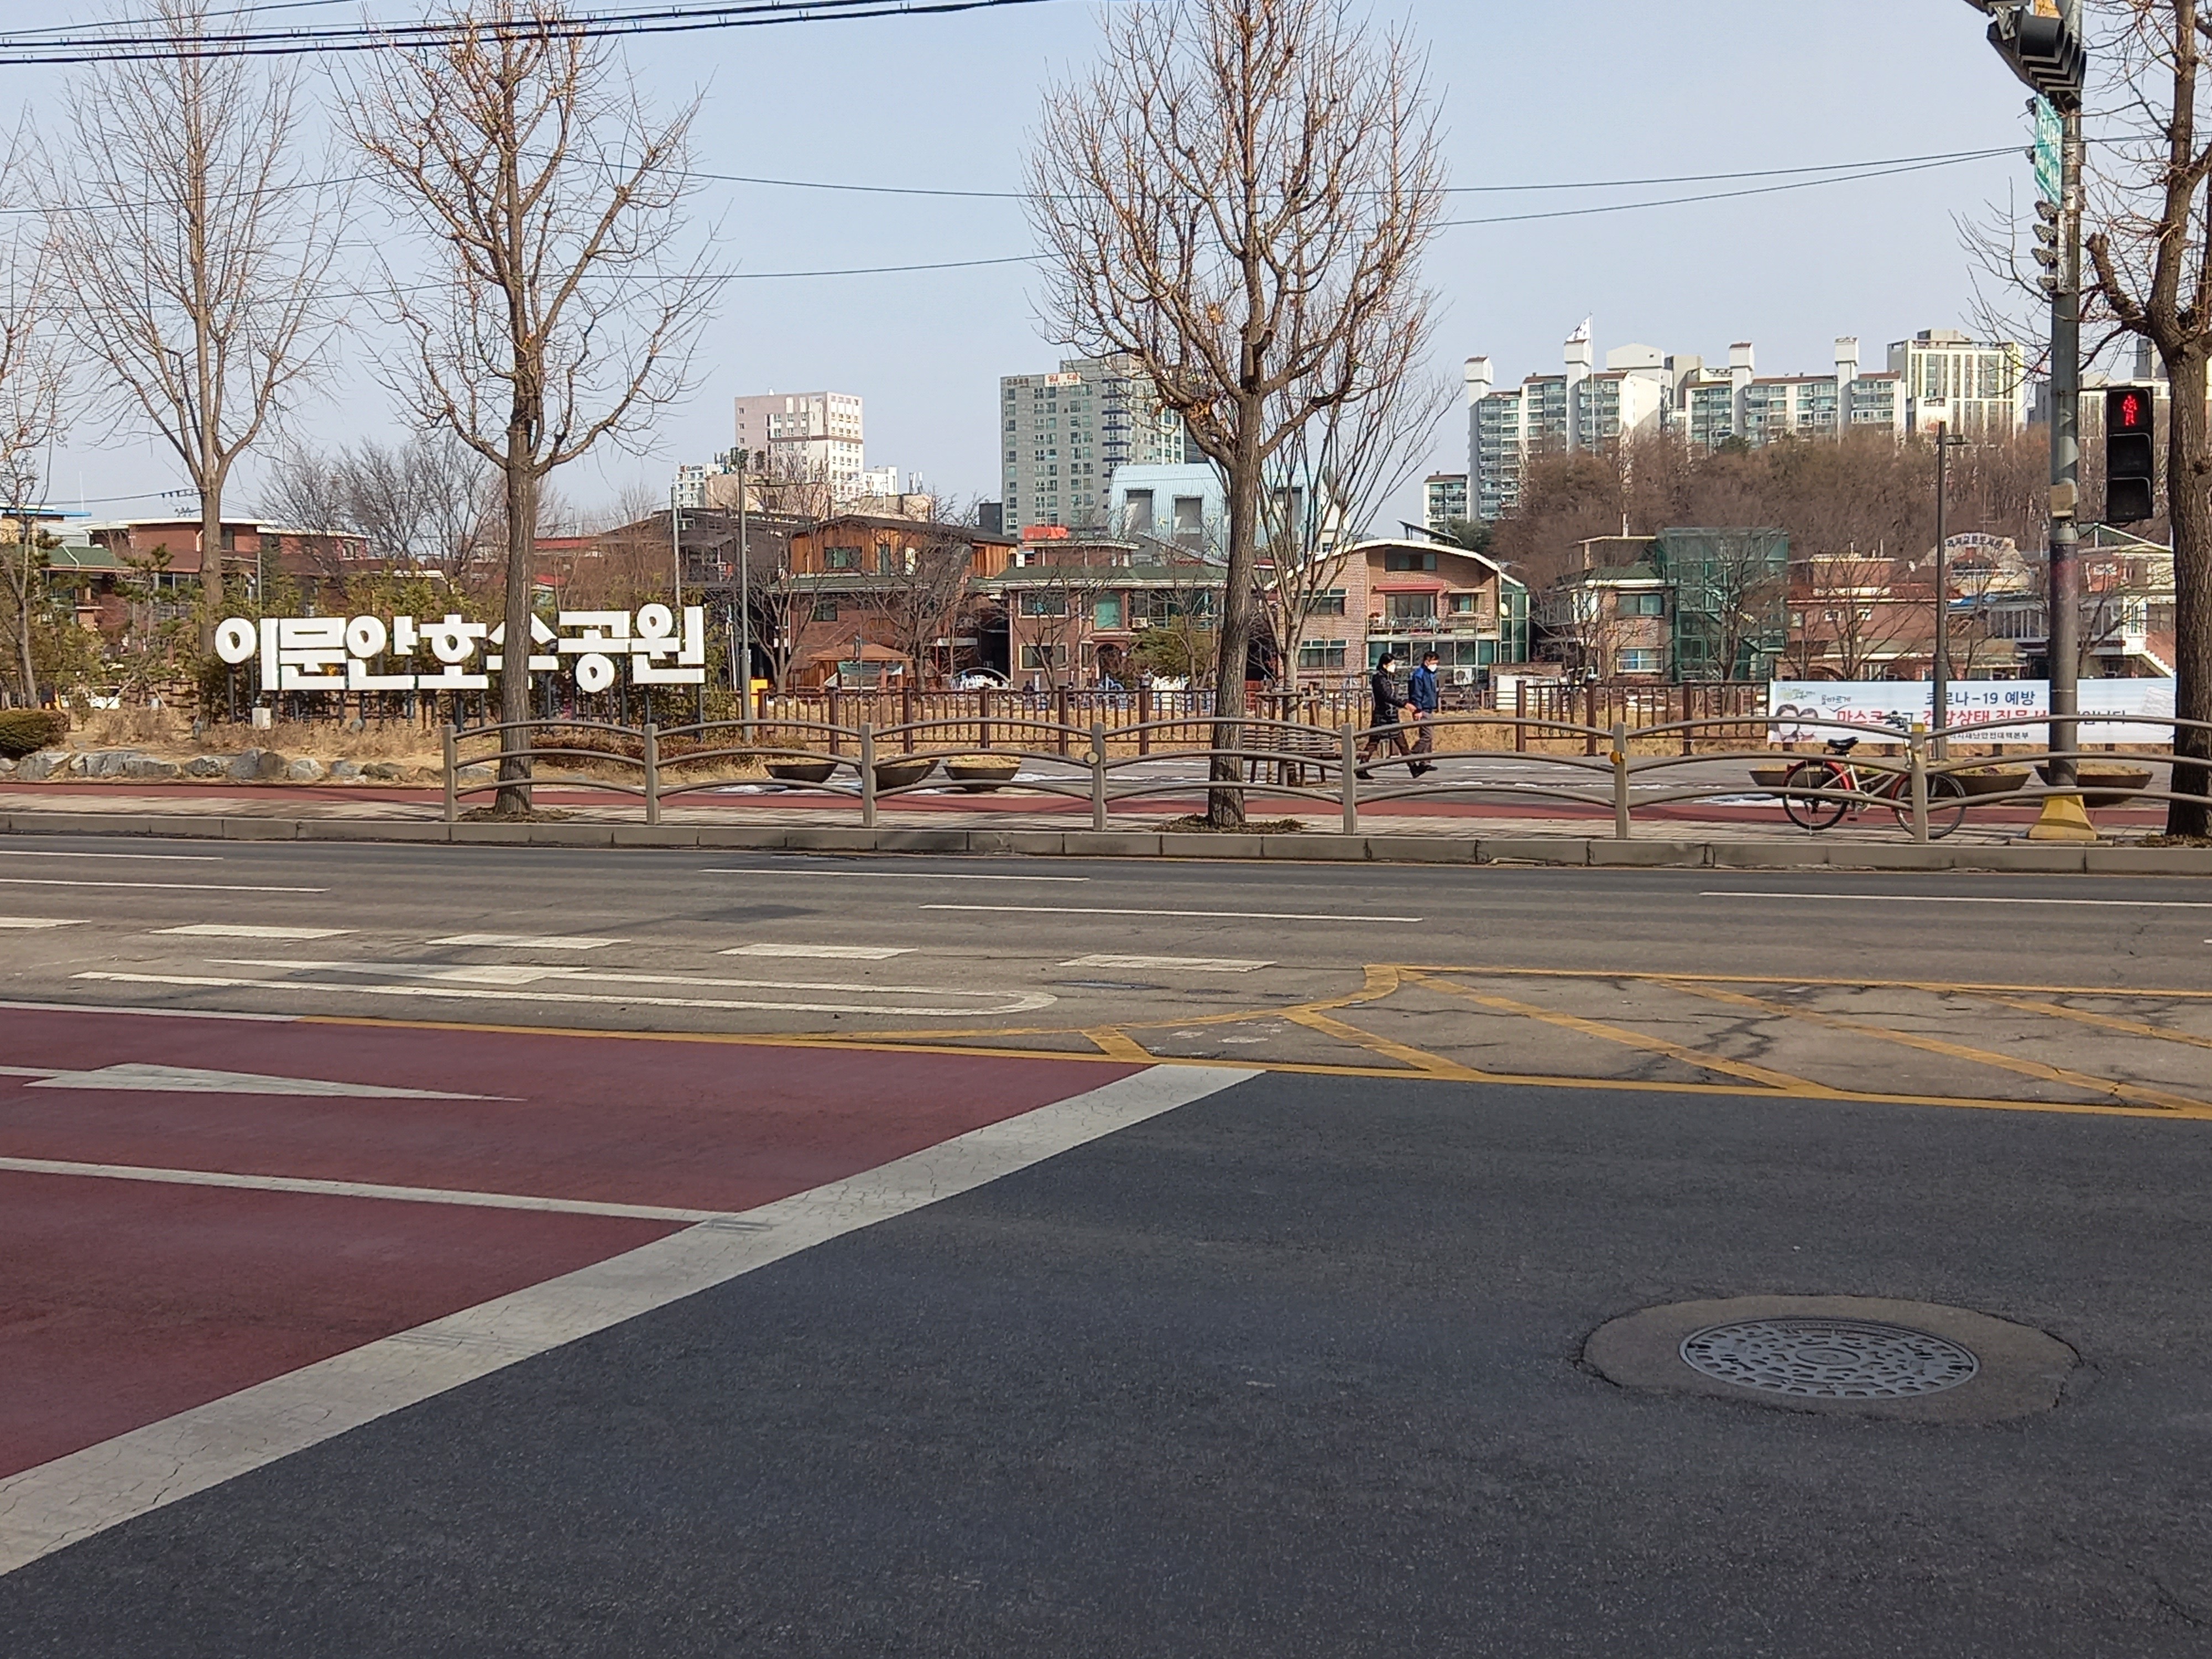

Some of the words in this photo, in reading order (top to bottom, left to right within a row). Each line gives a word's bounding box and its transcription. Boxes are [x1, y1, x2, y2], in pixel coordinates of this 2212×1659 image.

[215, 603, 705, 692] 이문안호수공원
[1821, 695, 1851, 705] 올바르게
[2005, 691, 2035, 705] 예방
[1837, 710, 1883, 724] 마스크
